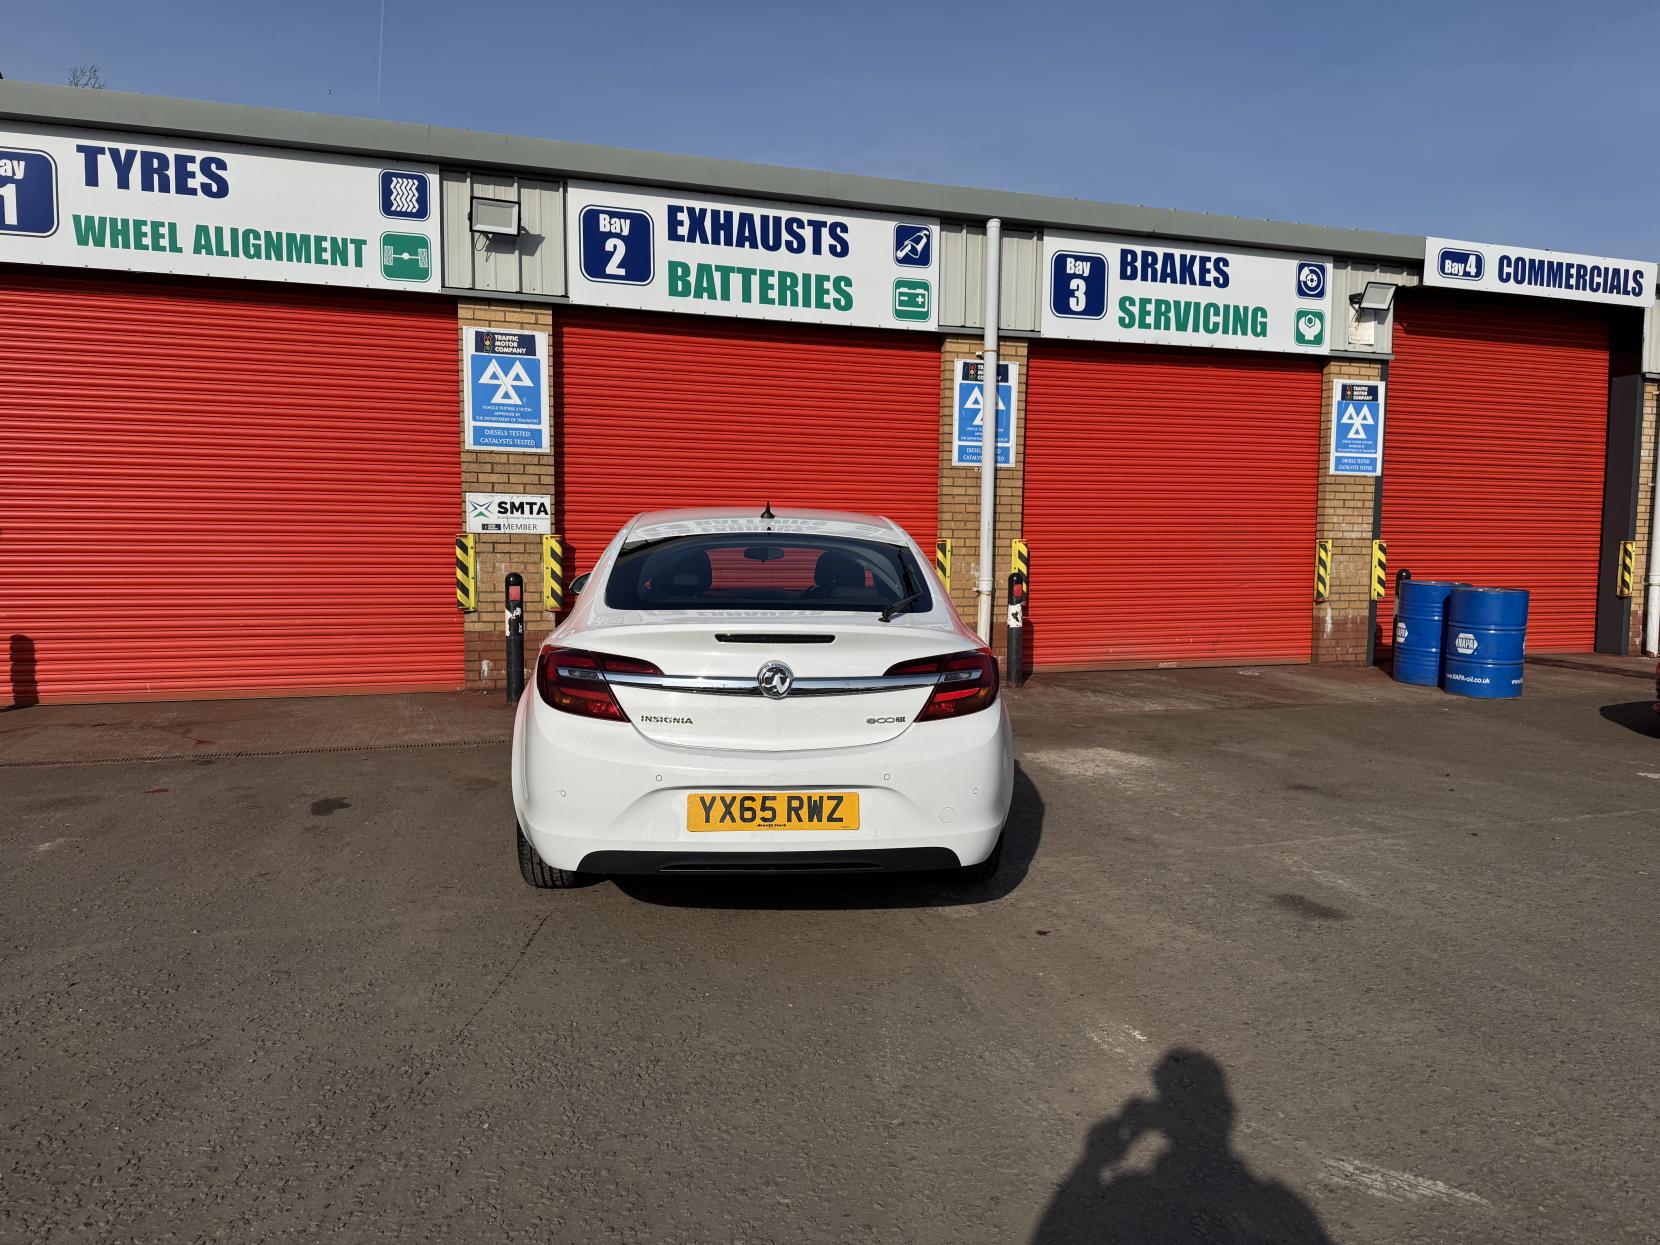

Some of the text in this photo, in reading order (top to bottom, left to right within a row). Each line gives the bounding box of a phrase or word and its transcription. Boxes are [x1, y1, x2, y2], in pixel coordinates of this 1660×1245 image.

[0, 158, 26, 180] ay
[76, 144, 230, 199] TYRES
[0, 183, 18, 226] 1
[599, 213, 631, 236] Bay
[666, 204, 850, 258] EXHAUSTS
[72, 214, 368, 268] WHEEL ALIGNMENT
[604, 237, 626, 276] 2
[1066, 257, 1091, 277] Bay
[1119, 248, 1230, 289] BRAKES
[1444, 254, 1477, 277] Bay 4
[667, 260, 854, 312] BATTERIES
[1497, 254, 1645, 298] COMMERCIALS
[1068, 278, 1087, 312] 3
[1118, 295, 1268, 338] SERVICING
[494, 334, 519, 342] TRAFFIC
[494, 340, 518, 348] MOTOR
[494, 346, 527, 354] COMPANY
[480, 437, 513, 445] CATALYSTS
[497, 500, 549, 516] SMTA
[503, 523, 538, 531] MEMBER
[641, 715, 694, 724] INSIGNIA
[699, 795, 844, 824] YX65 RWZ
